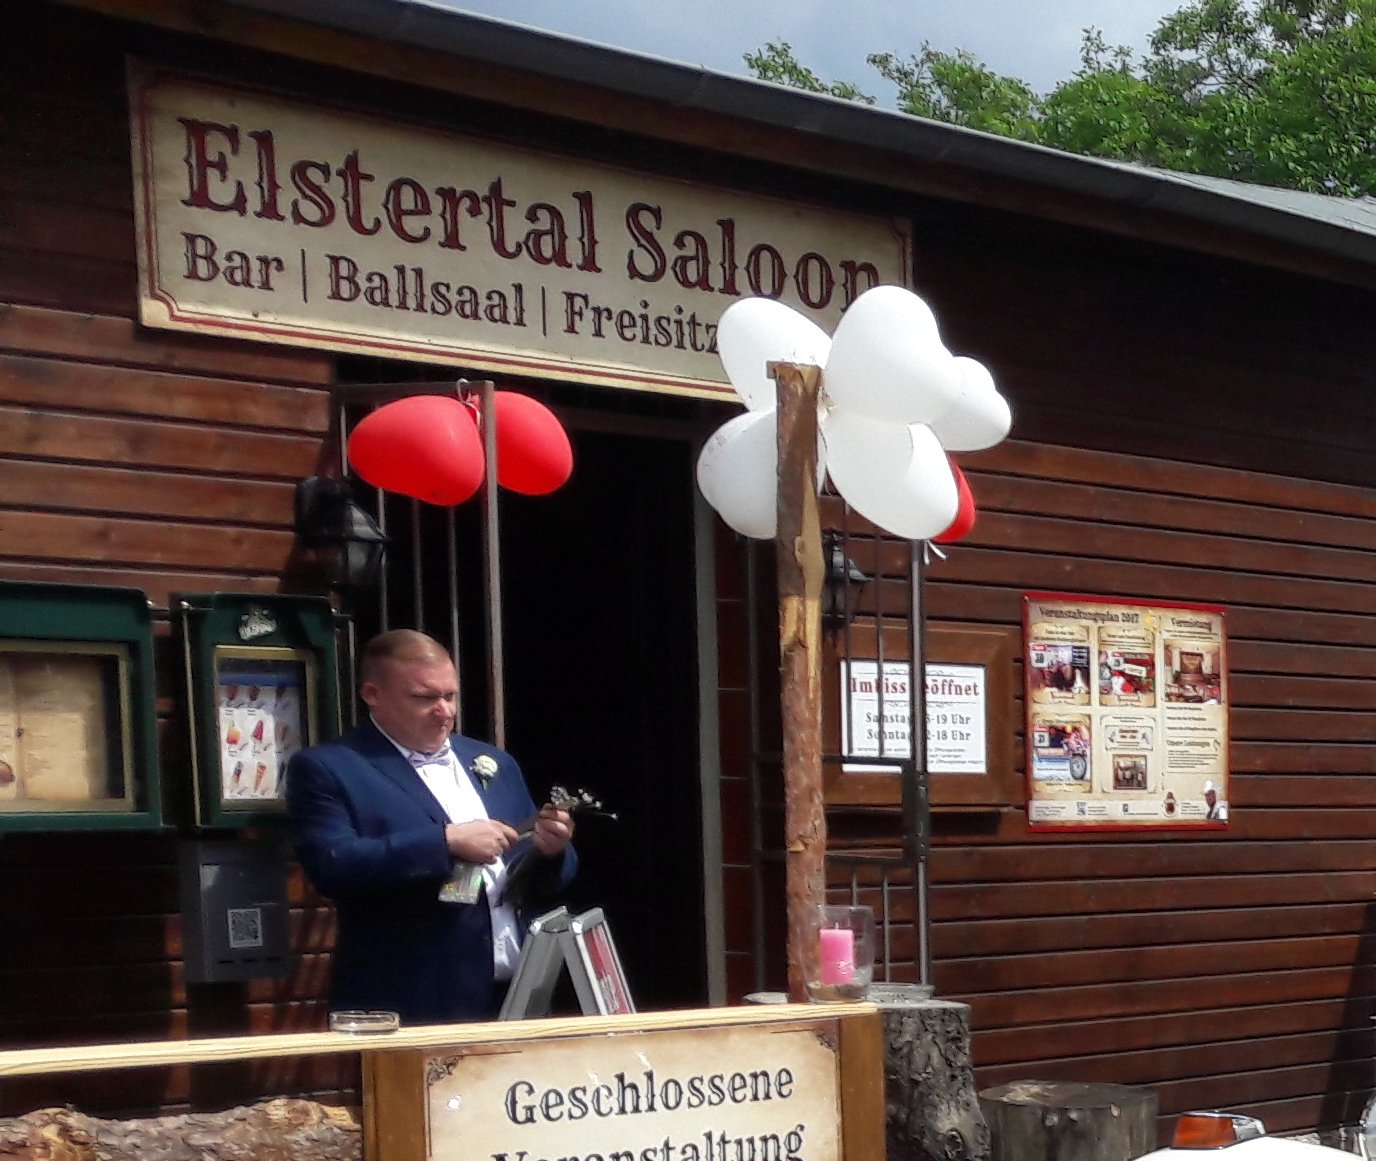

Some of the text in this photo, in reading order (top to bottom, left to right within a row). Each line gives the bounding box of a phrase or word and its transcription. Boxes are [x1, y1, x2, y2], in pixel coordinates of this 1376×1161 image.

[177, 116, 880, 312] Elstertal Saloon
[180, 231, 719, 355] Bar Ballsaal Freisitz
[951, 713, 971, 725] Uhr
[951, 730, 971, 741] Uhr
[504, 1066, 795, 1126] Geschlossene
